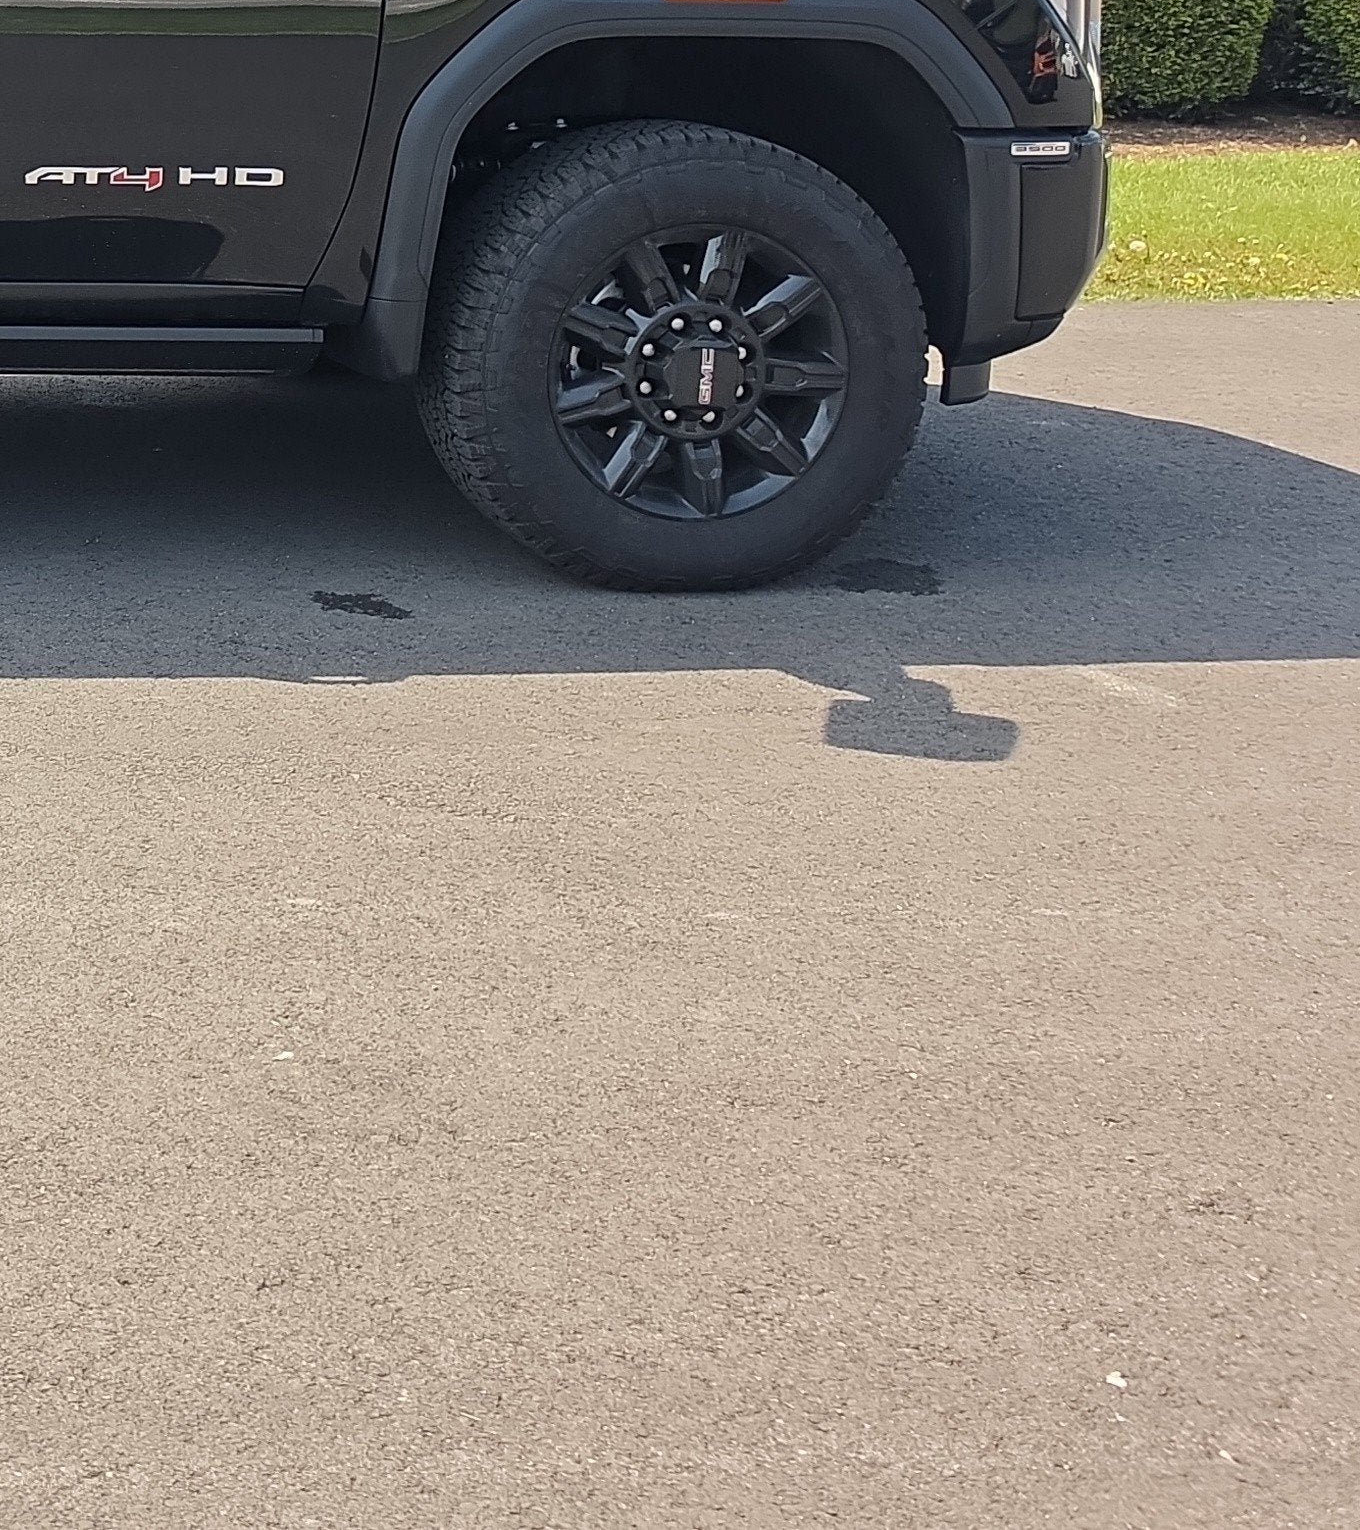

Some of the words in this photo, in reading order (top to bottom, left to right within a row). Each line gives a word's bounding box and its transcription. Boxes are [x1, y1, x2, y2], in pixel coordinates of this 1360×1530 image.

[25, 166, 164, 192] AT4
[179, 166, 284, 187] HD
[698, 348, 715, 405] GMC
